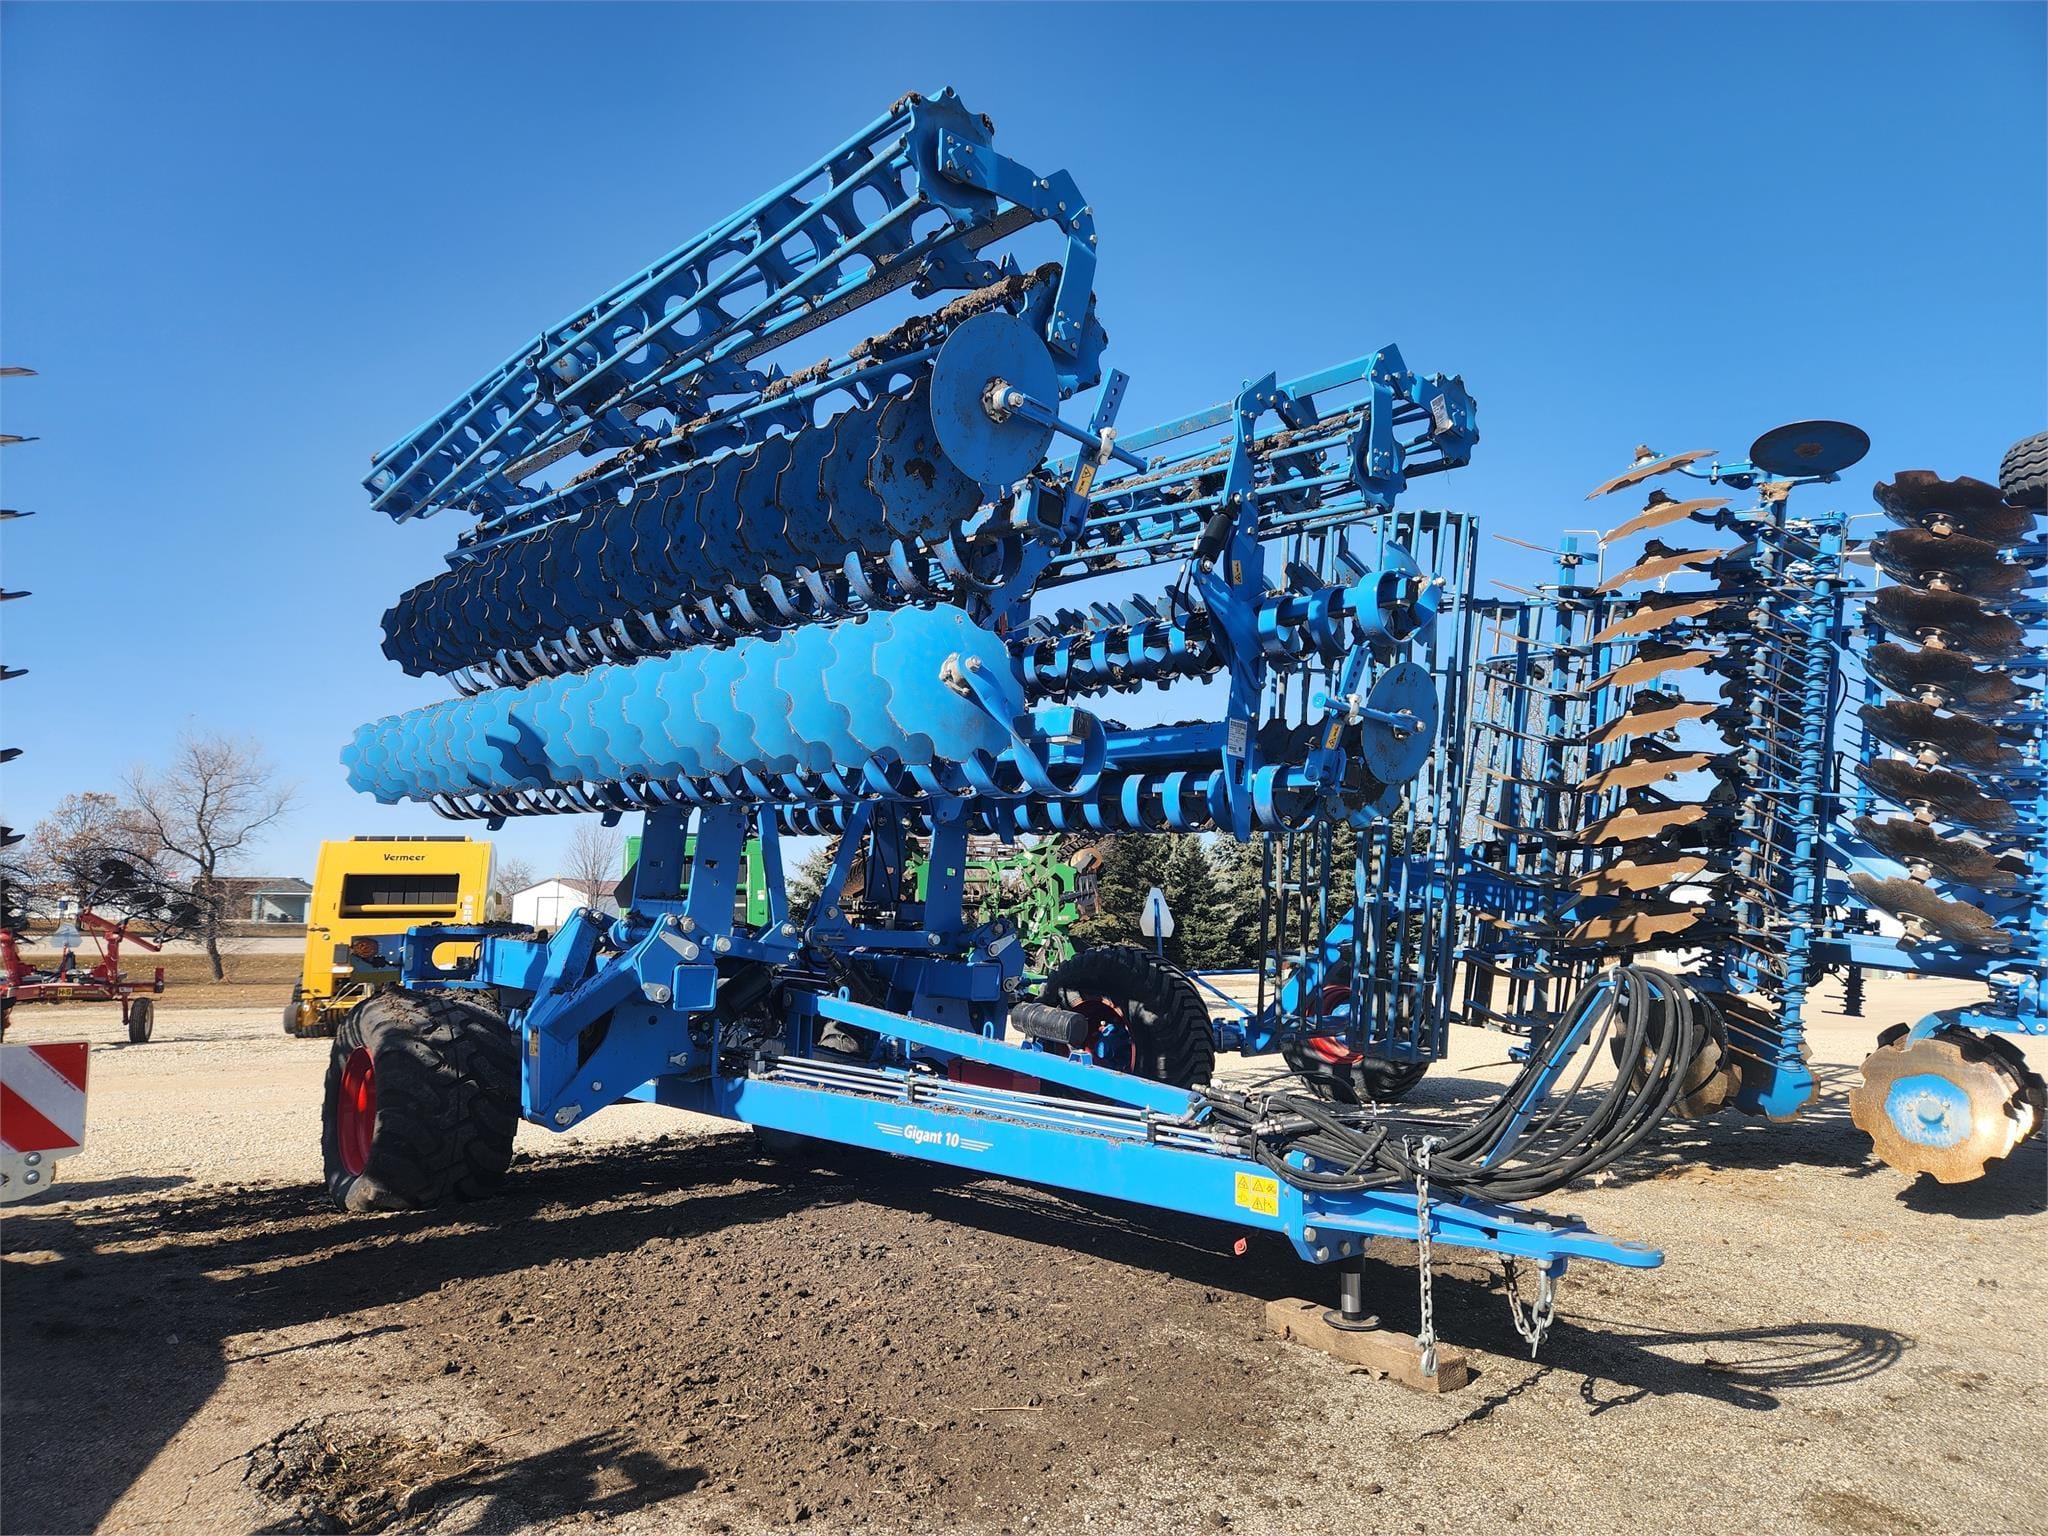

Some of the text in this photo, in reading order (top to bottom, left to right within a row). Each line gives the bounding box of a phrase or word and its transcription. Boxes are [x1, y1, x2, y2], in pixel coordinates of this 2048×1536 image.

[383, 853, 425, 861] Vermeer
[904, 1124, 960, 1147] Gigant 10
